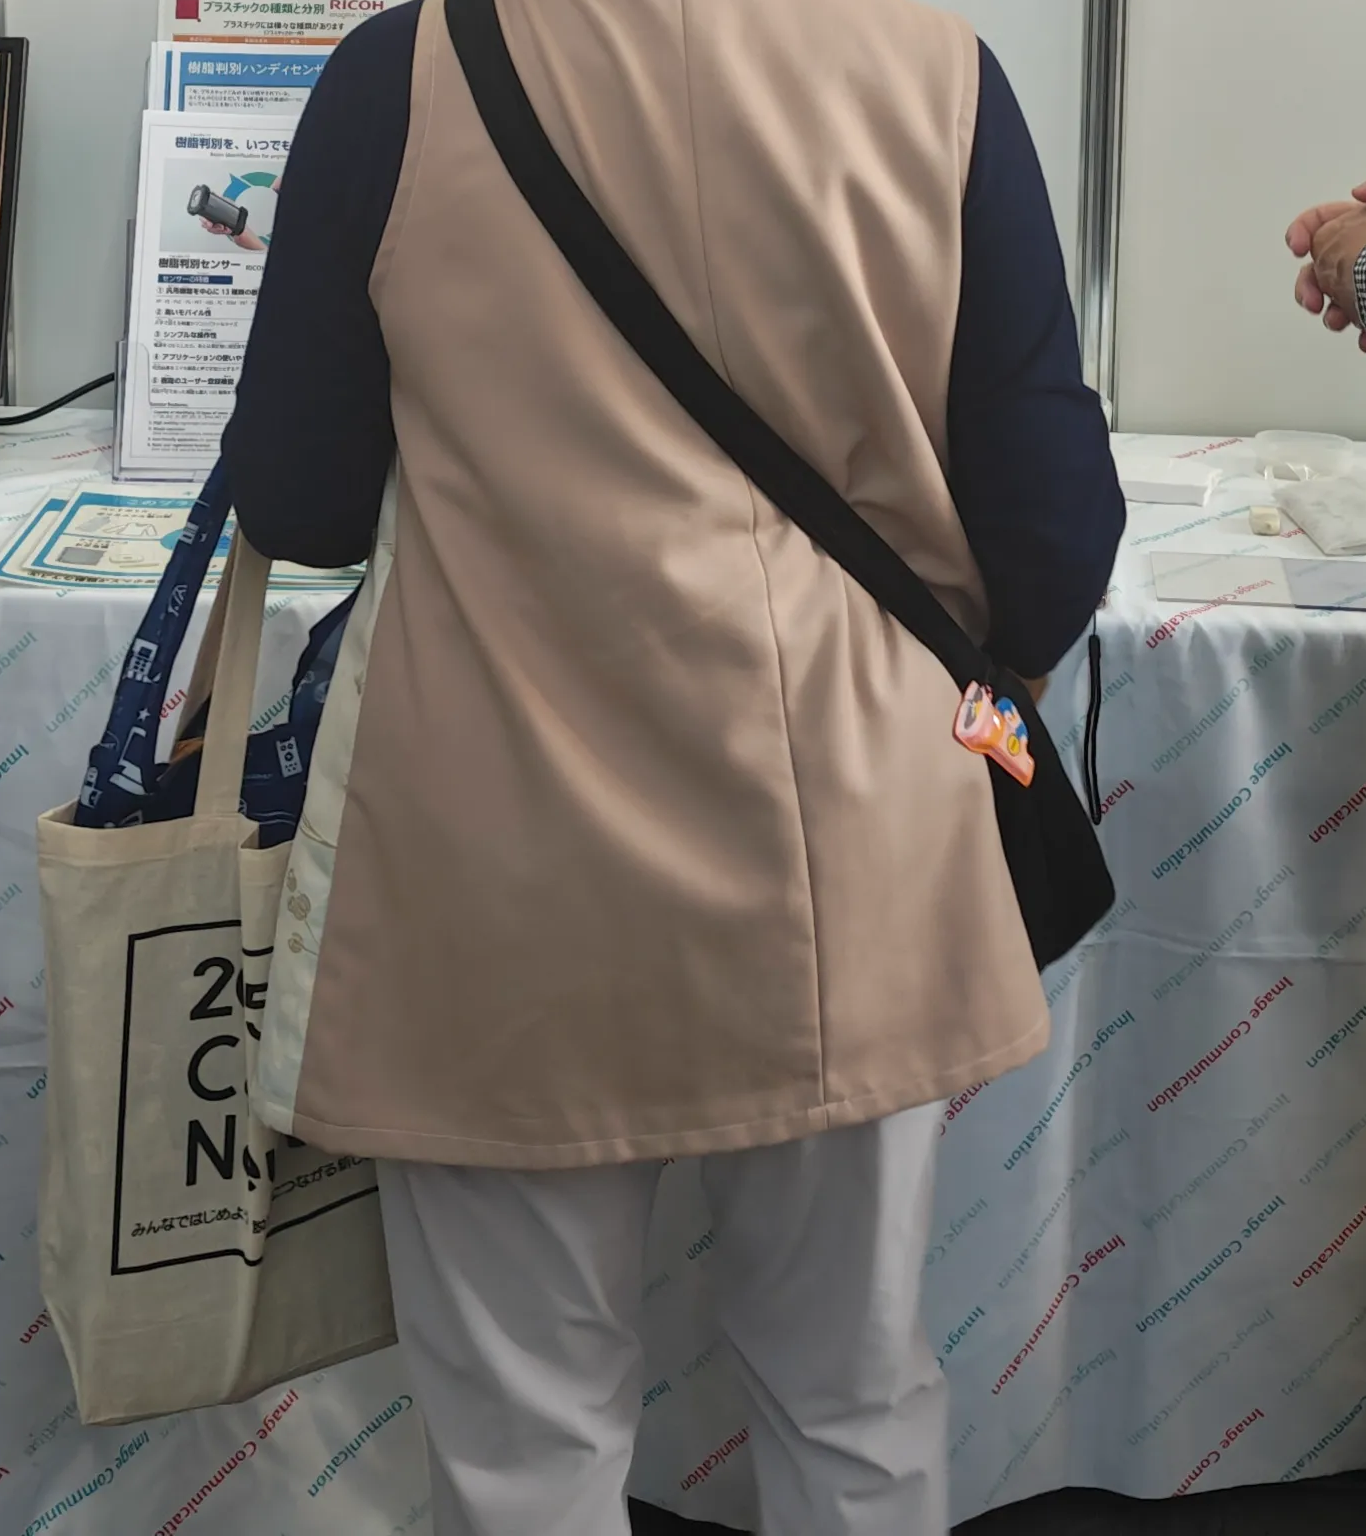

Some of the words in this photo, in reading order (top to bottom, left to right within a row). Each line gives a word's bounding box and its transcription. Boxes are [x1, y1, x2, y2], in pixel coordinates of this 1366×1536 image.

[204, 2, 324, 14] プラスチックの種類と分別
[329, 0, 384, 10] RICOH
[1250, 741, 1294, 785] Image
[1151, 783, 1252, 881] Communication
[1078, 1234, 1126, 1275] Image
[991, 1273, 1081, 1397] Communication
